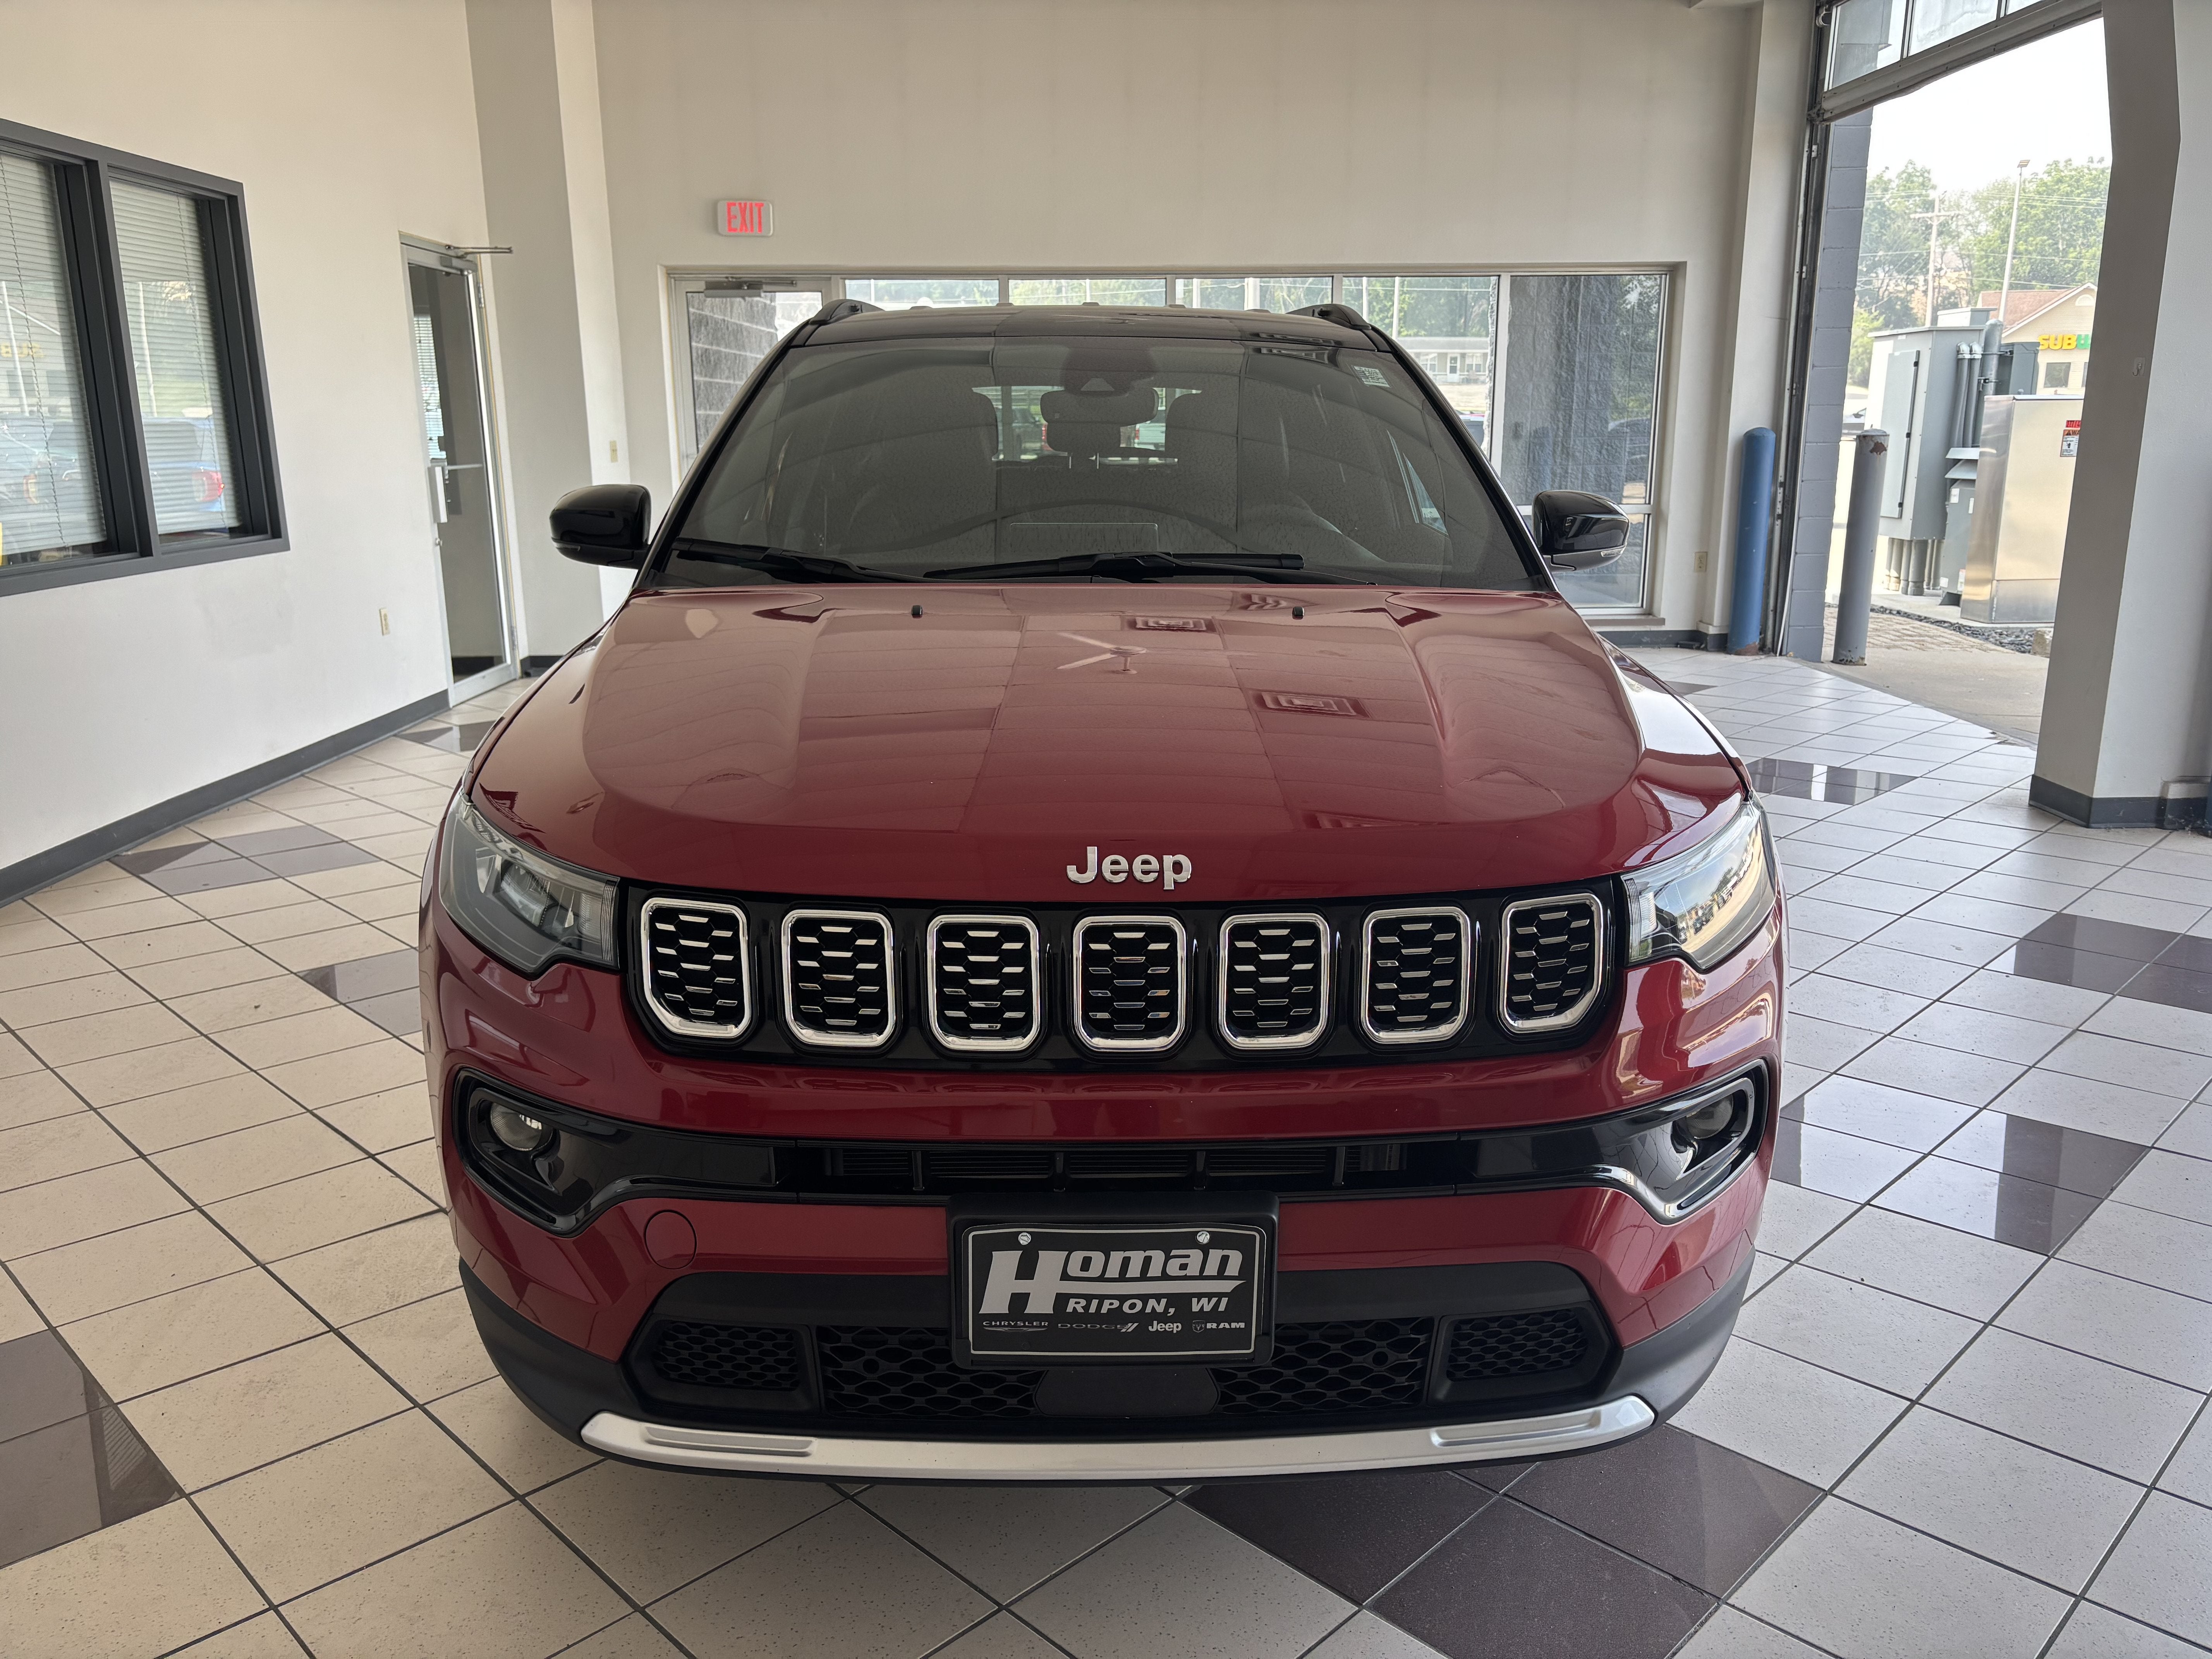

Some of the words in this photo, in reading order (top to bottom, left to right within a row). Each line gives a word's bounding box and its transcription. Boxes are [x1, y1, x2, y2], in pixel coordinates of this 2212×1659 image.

[726, 202, 764, 233] EXIT
[1066, 846, 1192, 890] Jeep
[979, 1249, 1246, 1314] Homan
[1066, 1298, 1176, 1316] RIPON,
[1192, 1297, 1228, 1312] WI
[1148, 1321, 1182, 1333] Jeep
